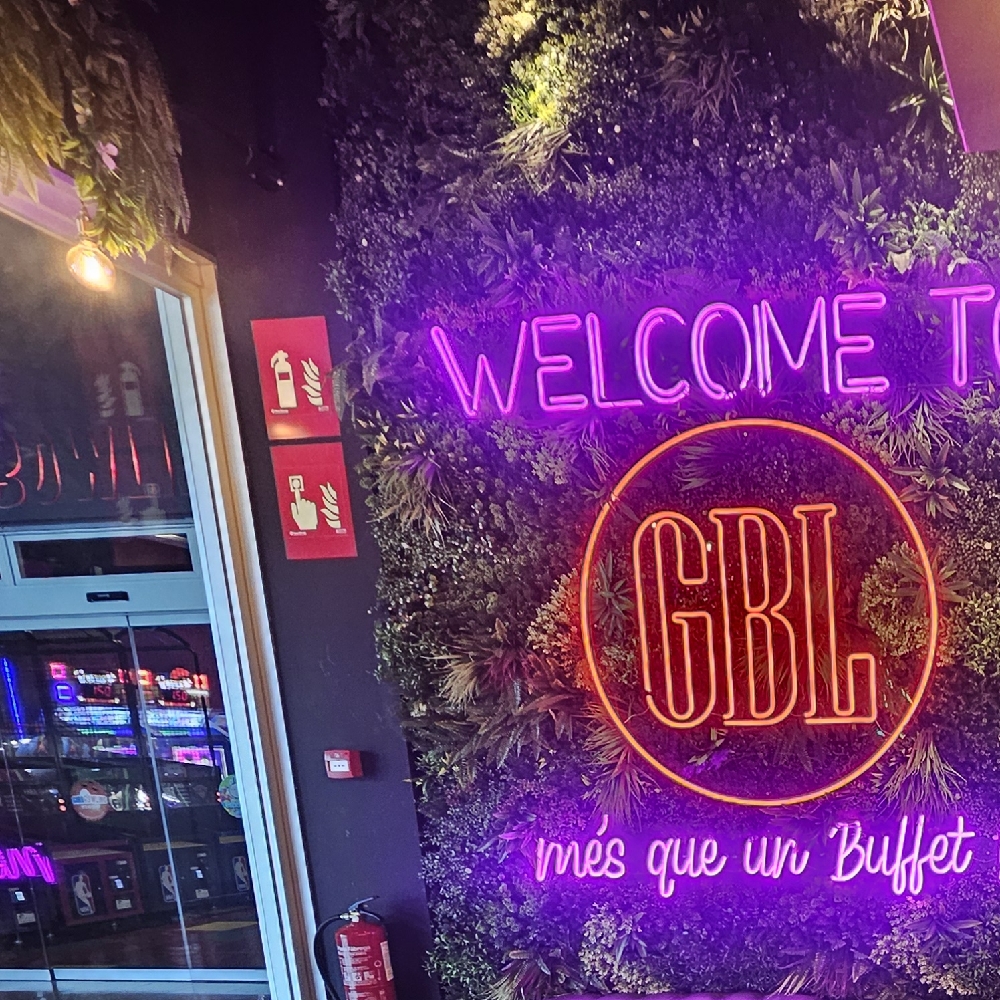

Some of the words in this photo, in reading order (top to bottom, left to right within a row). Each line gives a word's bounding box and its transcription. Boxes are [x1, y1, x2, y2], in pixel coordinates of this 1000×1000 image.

[430, 291, 889, 418] WELCOME
[632, 502, 877, 729] GBL
[534, 814, 626, 881] més
[646, 836, 727, 898] que
[741, 834, 810, 876] un
[828, 815, 976, 896] Buffet
